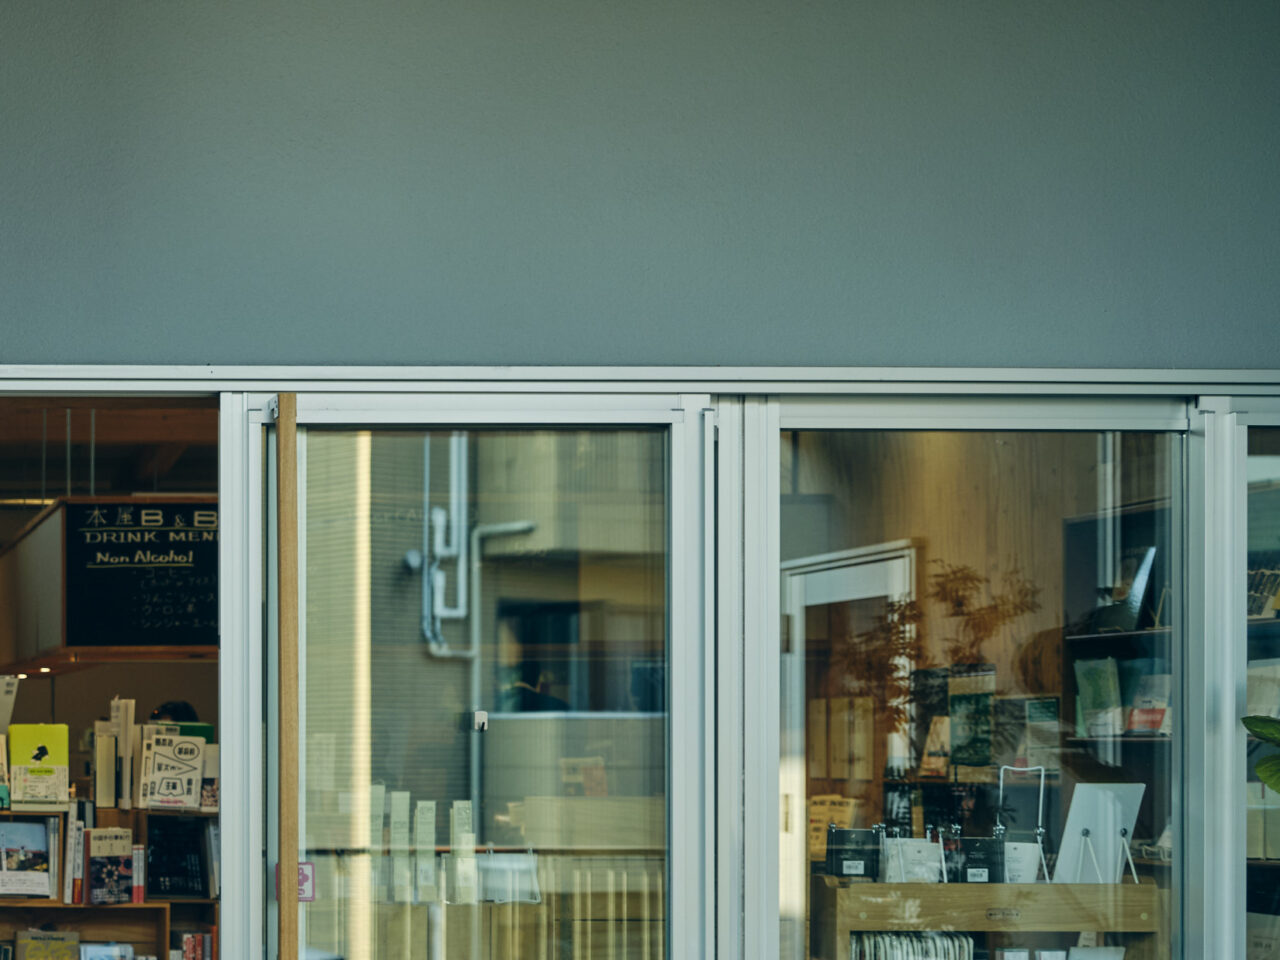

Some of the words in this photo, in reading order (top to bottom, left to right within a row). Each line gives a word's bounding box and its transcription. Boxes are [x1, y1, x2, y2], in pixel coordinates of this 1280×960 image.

[85, 531, 160, 543] DRINK
[169, 531, 219, 543] MEN
[96, 551, 130, 562] Non
[134, 550, 193, 562] Alcohol
